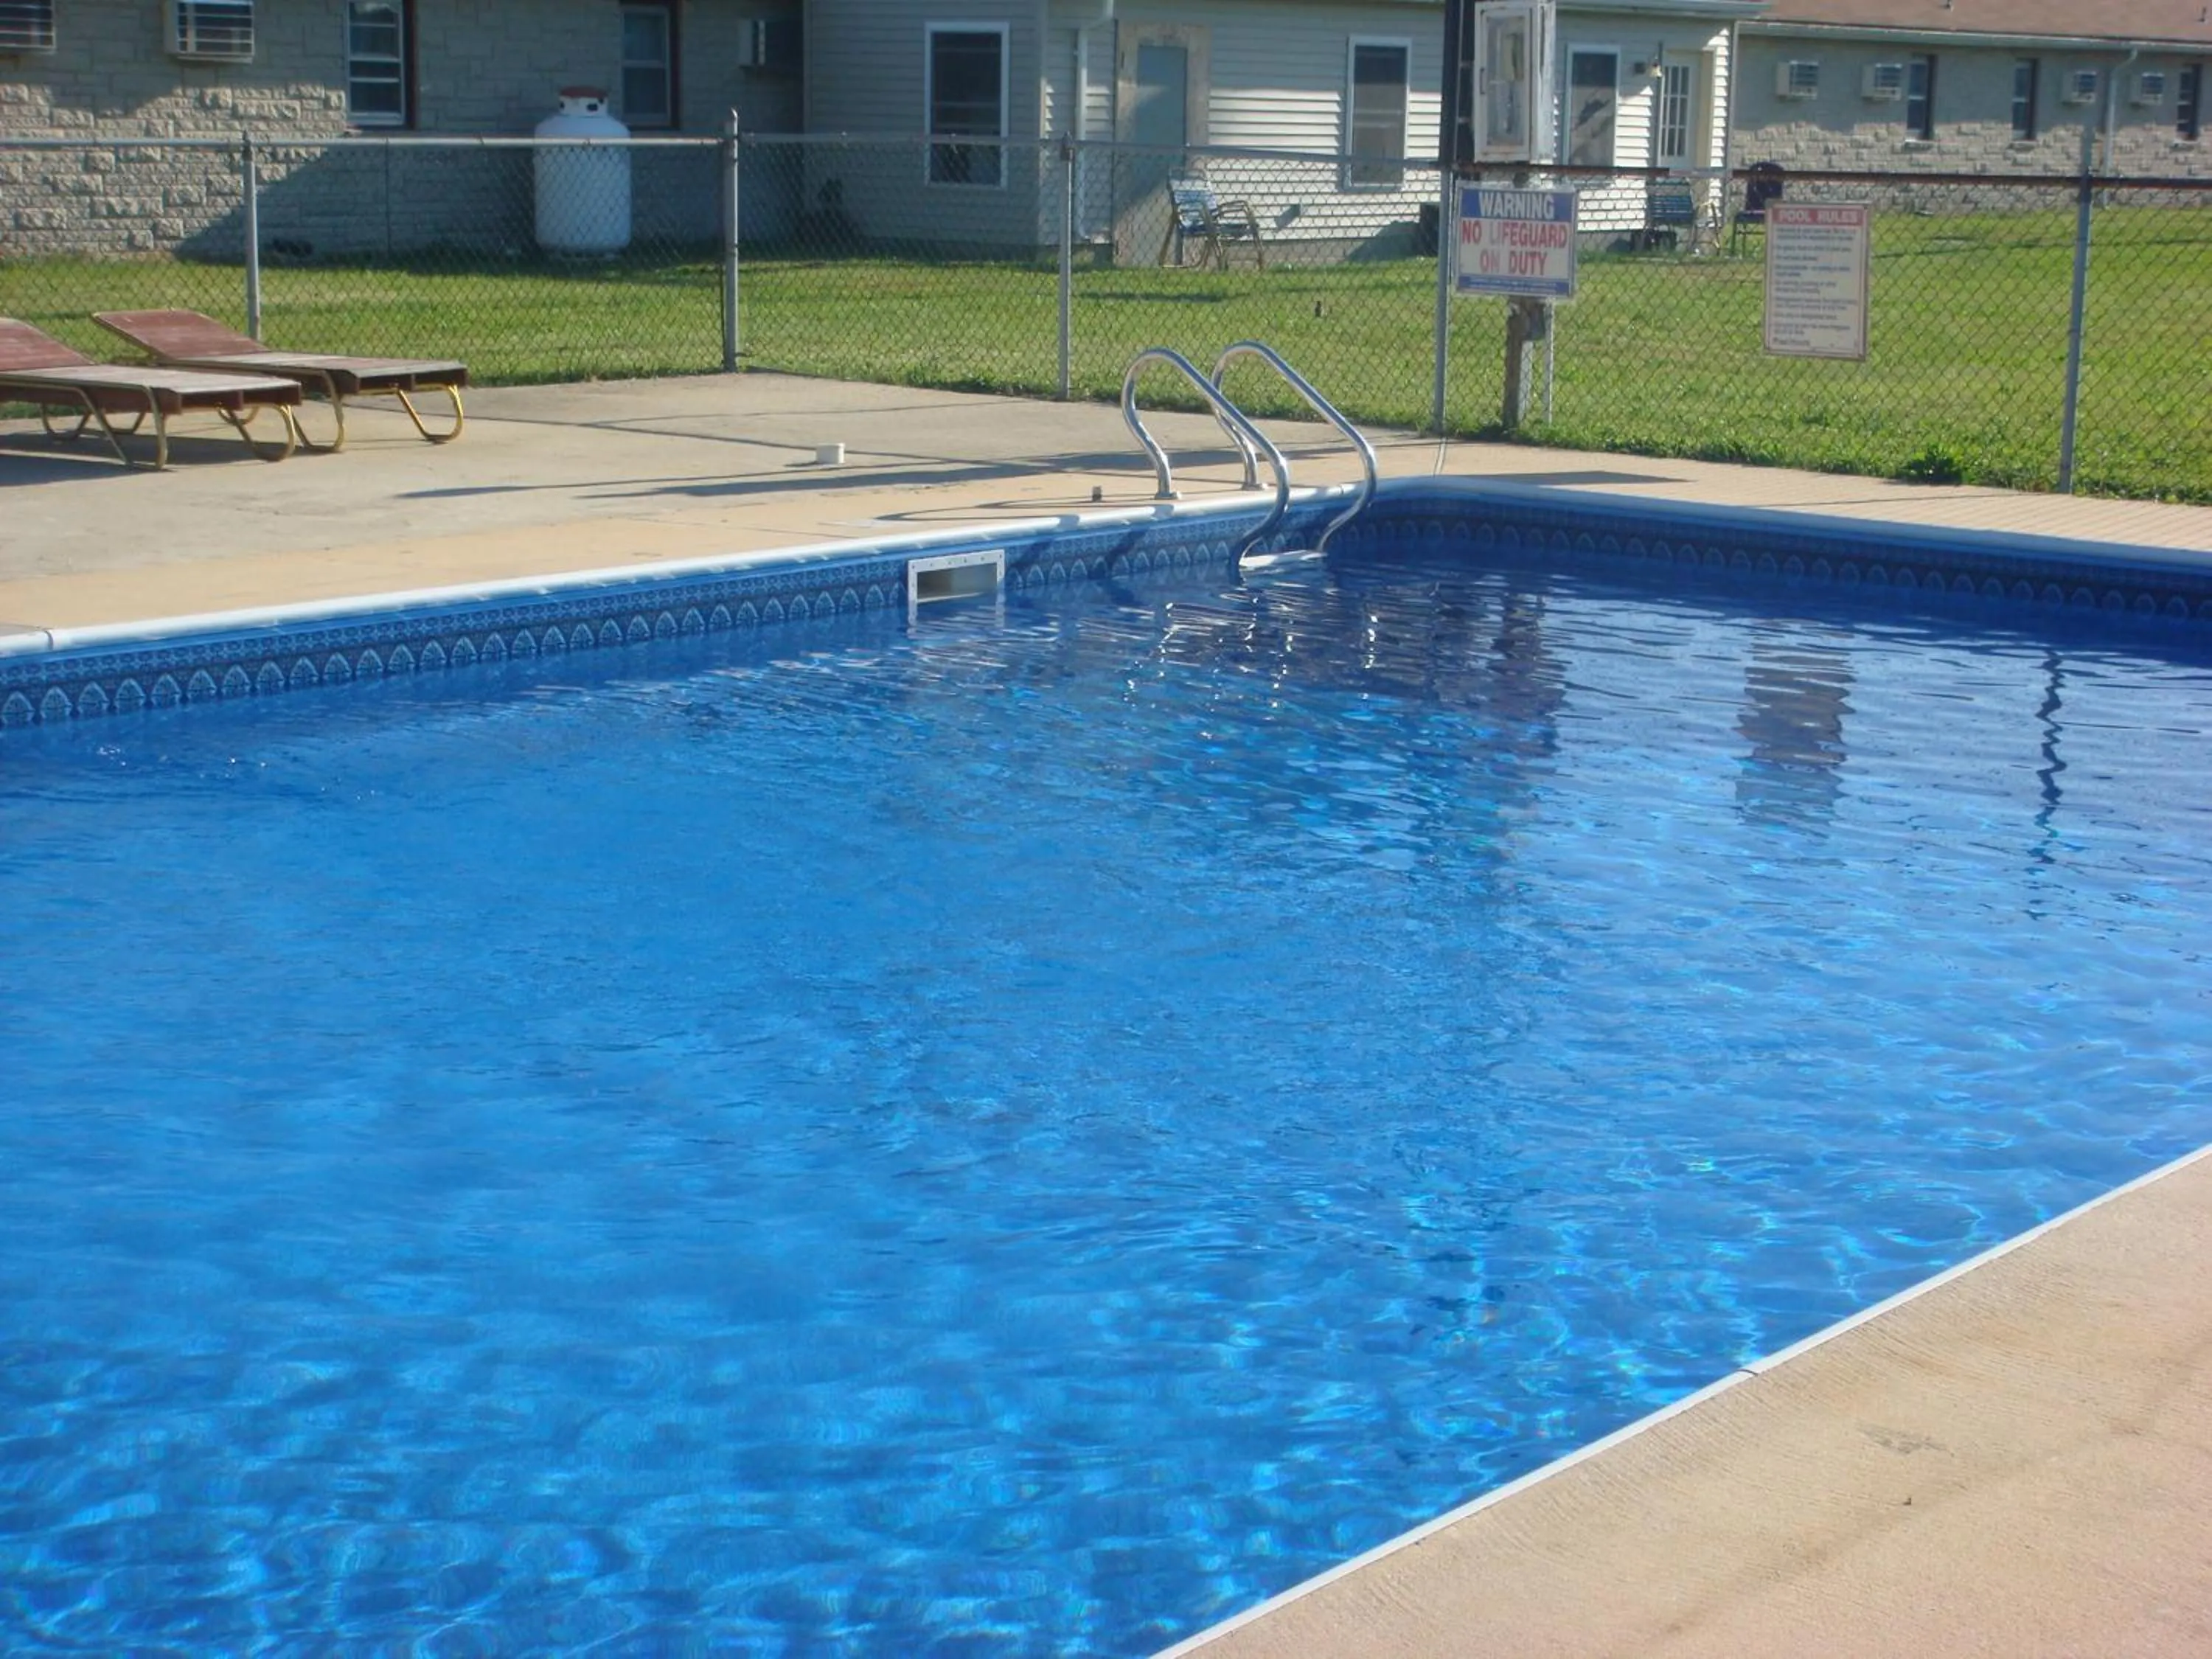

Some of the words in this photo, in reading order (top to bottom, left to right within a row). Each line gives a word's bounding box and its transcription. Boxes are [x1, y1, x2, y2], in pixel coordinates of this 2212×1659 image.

[1478, 191, 1555, 220] WARNING
[1778, 209, 1811, 223] POOL
[1817, 210, 1858, 223] RULES
[1461, 220, 1483, 245] NO
[1489, 222, 1568, 248] LIFEGUARD
[1479, 250, 1500, 273] ON
[1509, 251, 1548, 276] DUTY
